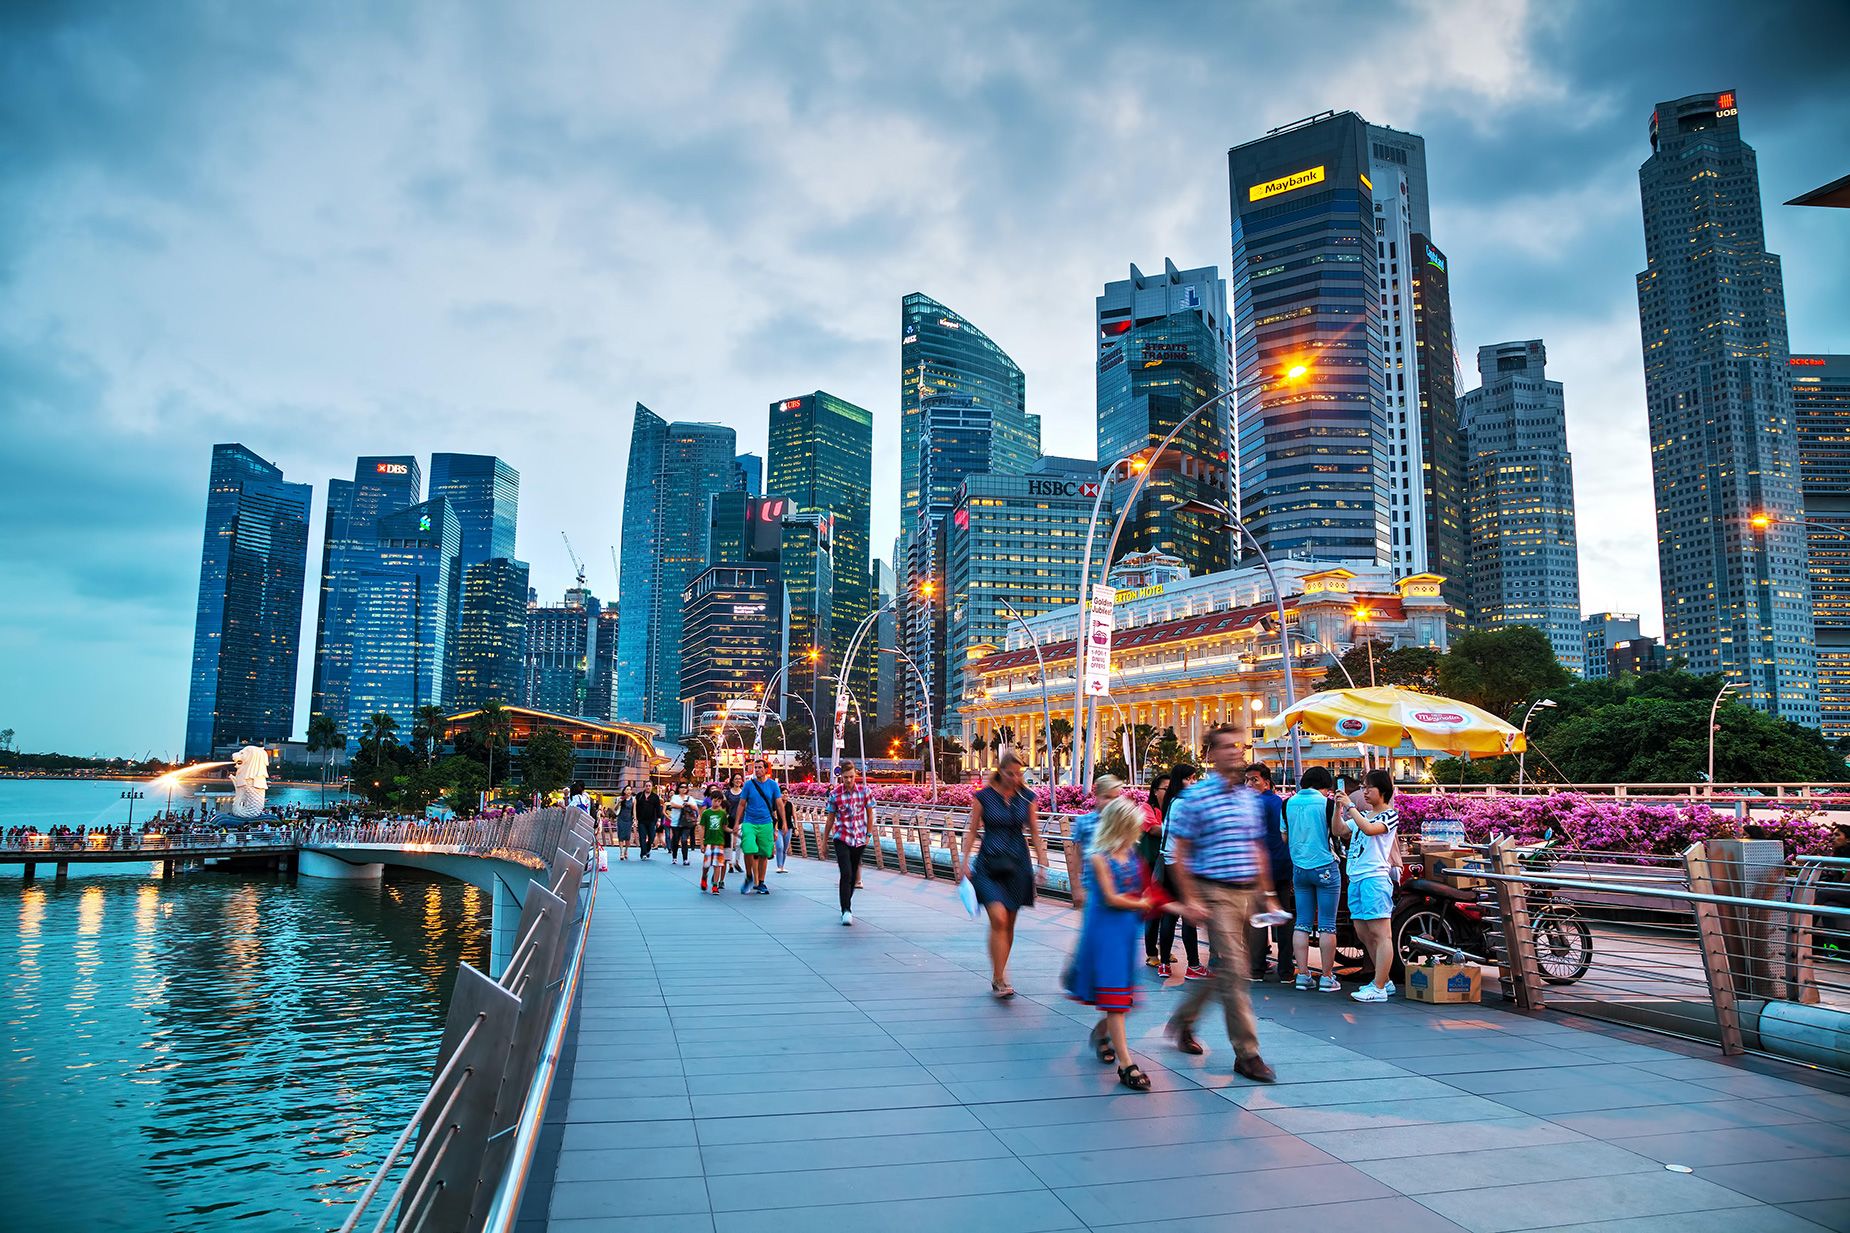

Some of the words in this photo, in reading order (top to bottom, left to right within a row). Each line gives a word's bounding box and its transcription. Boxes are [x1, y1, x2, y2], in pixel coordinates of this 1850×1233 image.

[1716, 108, 1738, 118] UOB
[1265, 171, 1317, 194] Maybank
[1144, 343, 1188, 351] STRAITS
[1142, 351, 1188, 360] TRADING
[1790, 358, 1809, 366] OCBC
[787, 400, 801, 409] UBS
[387, 464, 408, 474] DBS
[1028, 480, 1077, 497] HSBC
[1139, 584, 1164, 598] HOTEL
[1093, 596, 1113, 607] Golden
[1419, 714, 1461, 722] Magnolia
